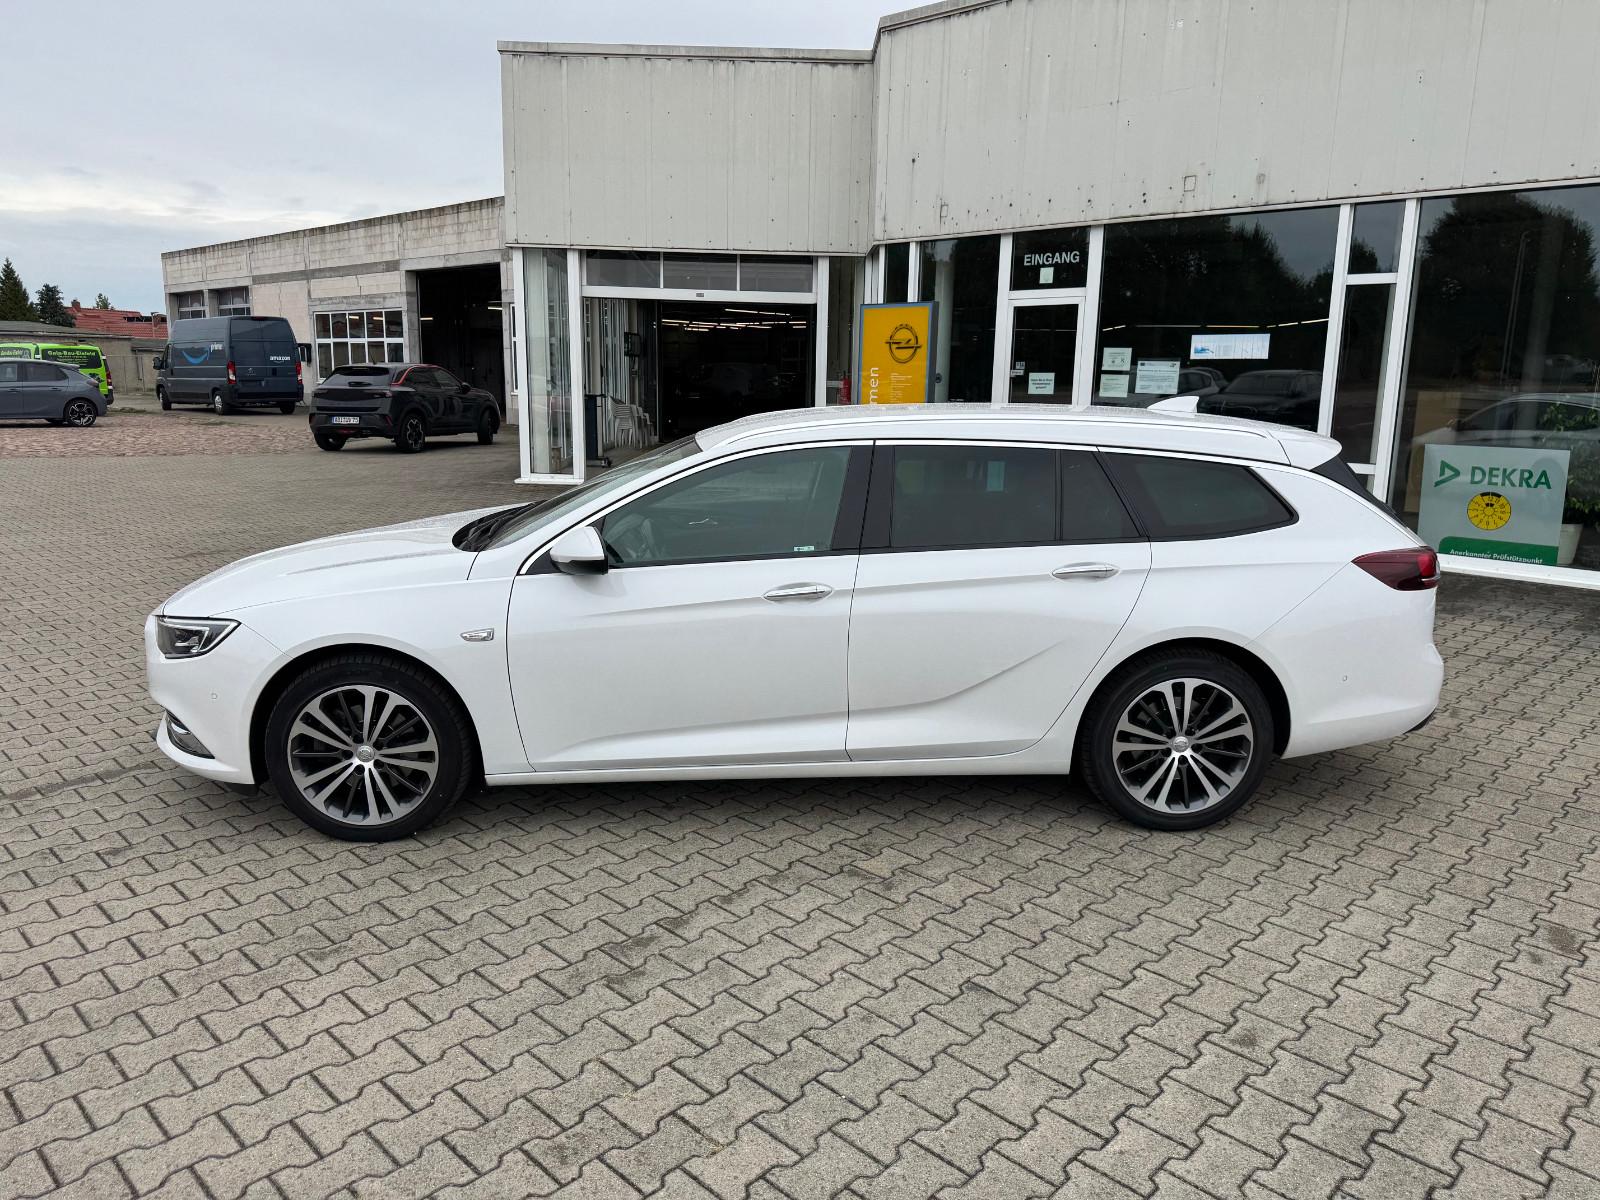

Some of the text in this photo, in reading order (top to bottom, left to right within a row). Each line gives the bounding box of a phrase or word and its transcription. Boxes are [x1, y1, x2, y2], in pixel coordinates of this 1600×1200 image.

[1023, 251, 1080, 265] EINGANG
[1470, 466, 1552, 490] DEKRA
[1450, 549, 1491, 558] Anerkannter
